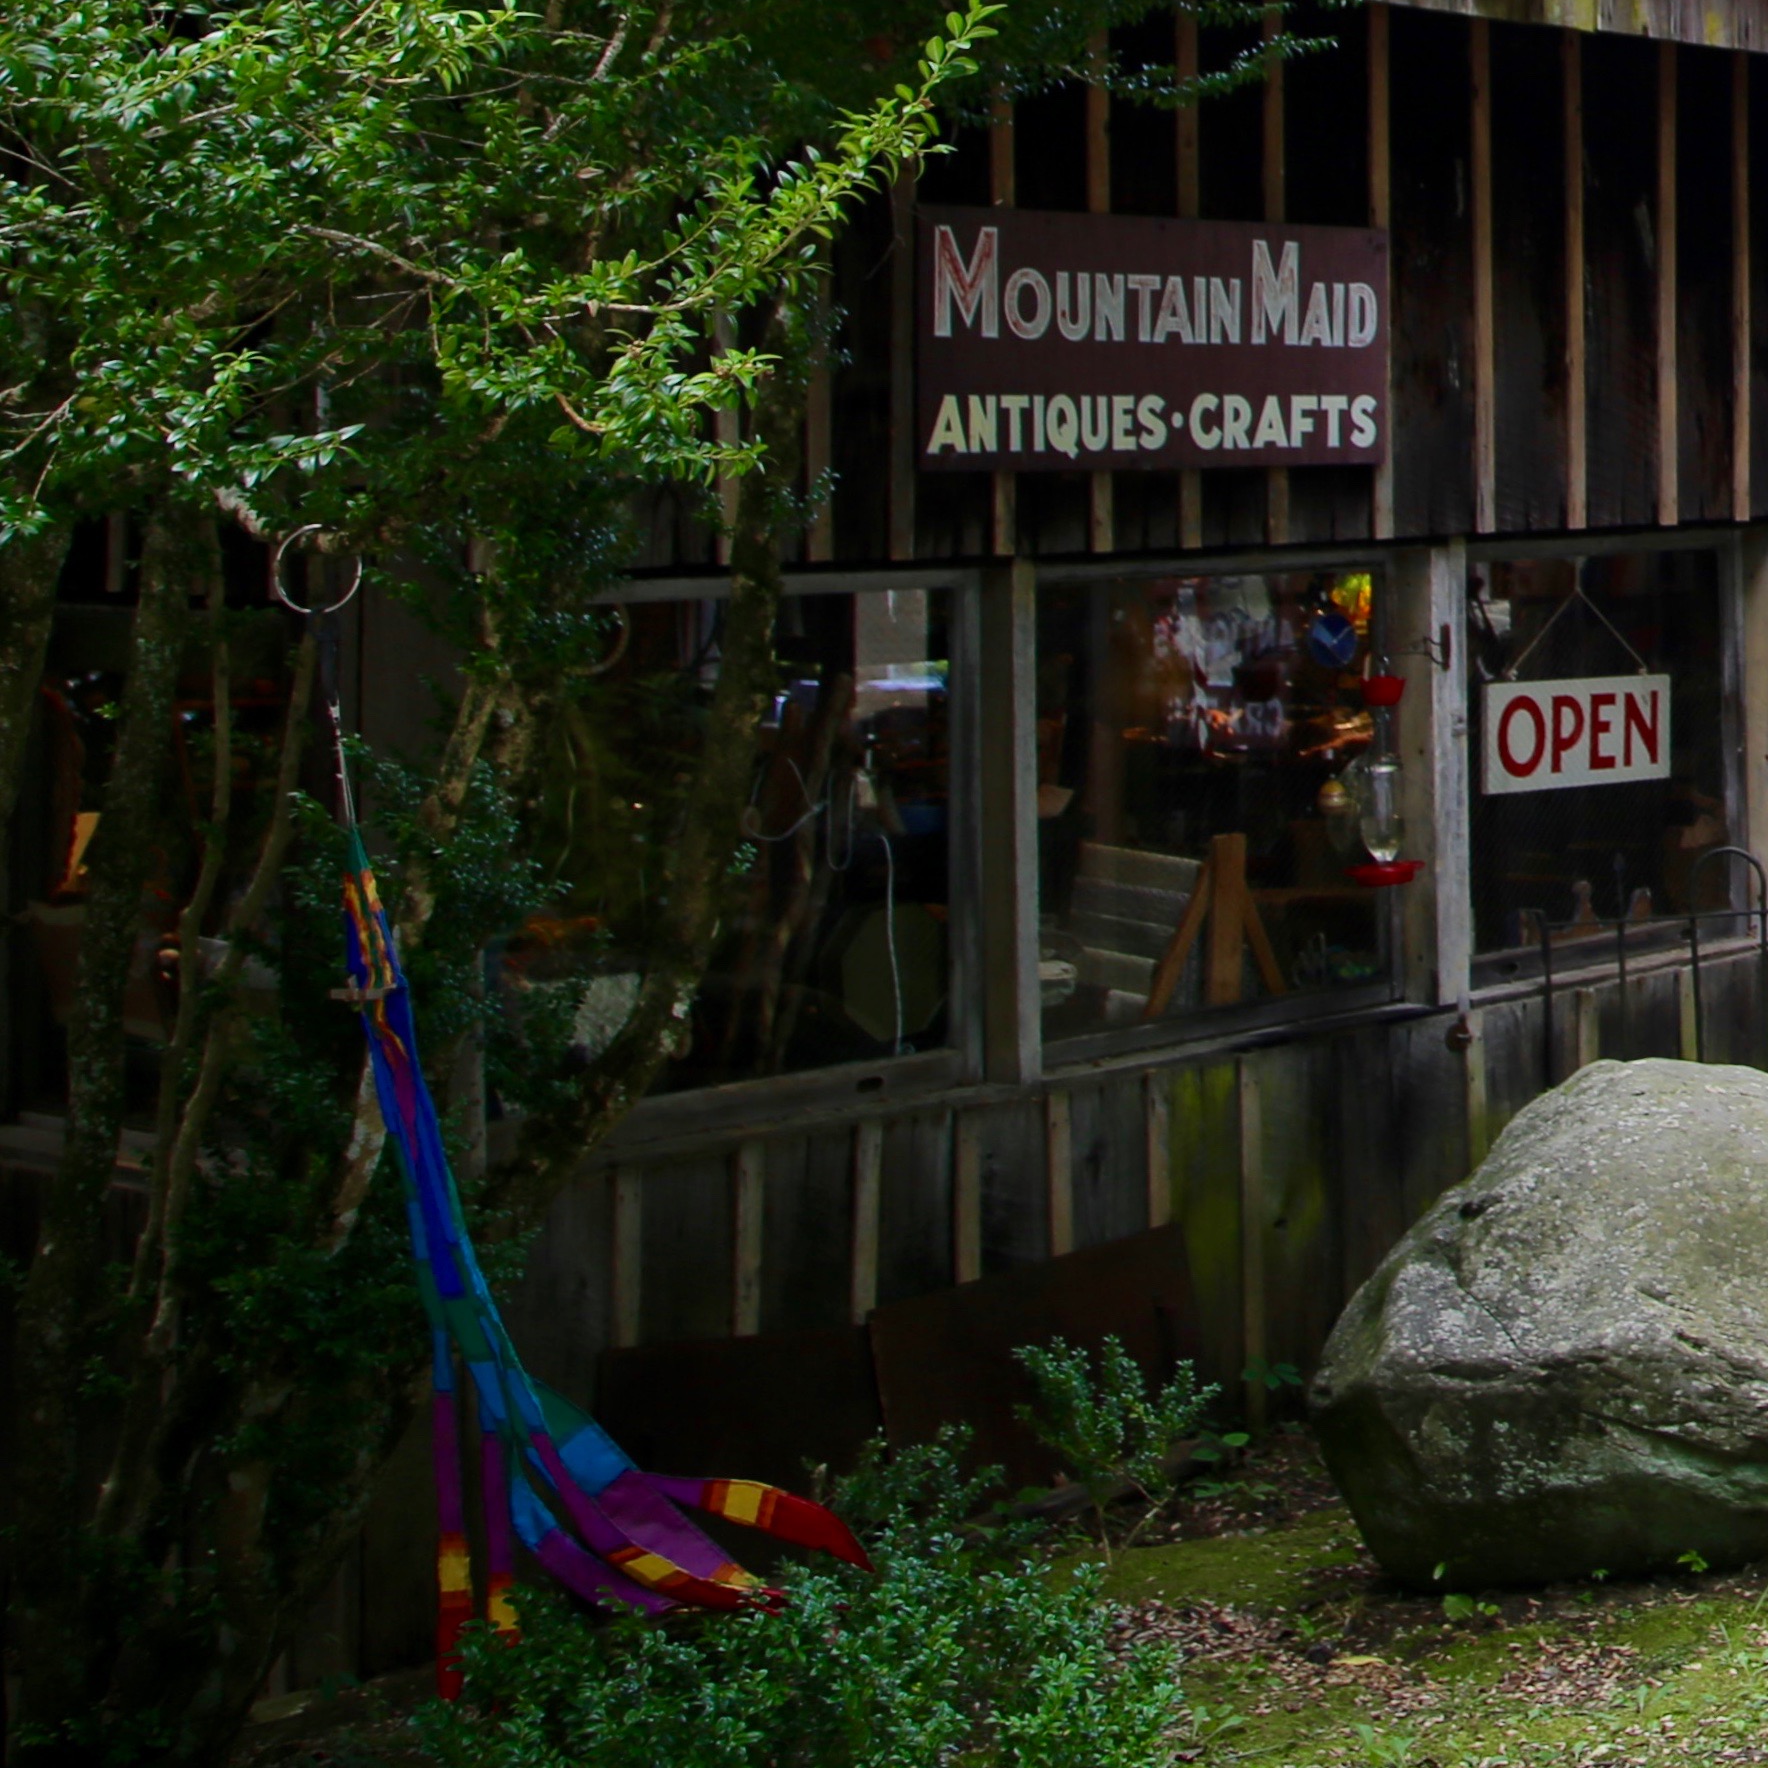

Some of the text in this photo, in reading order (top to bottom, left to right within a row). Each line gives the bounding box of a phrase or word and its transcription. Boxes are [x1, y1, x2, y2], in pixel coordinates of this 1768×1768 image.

[933, 224, 1378, 348] MOUNTAIN MAID
[1498, 689, 1660, 778] OPEN
